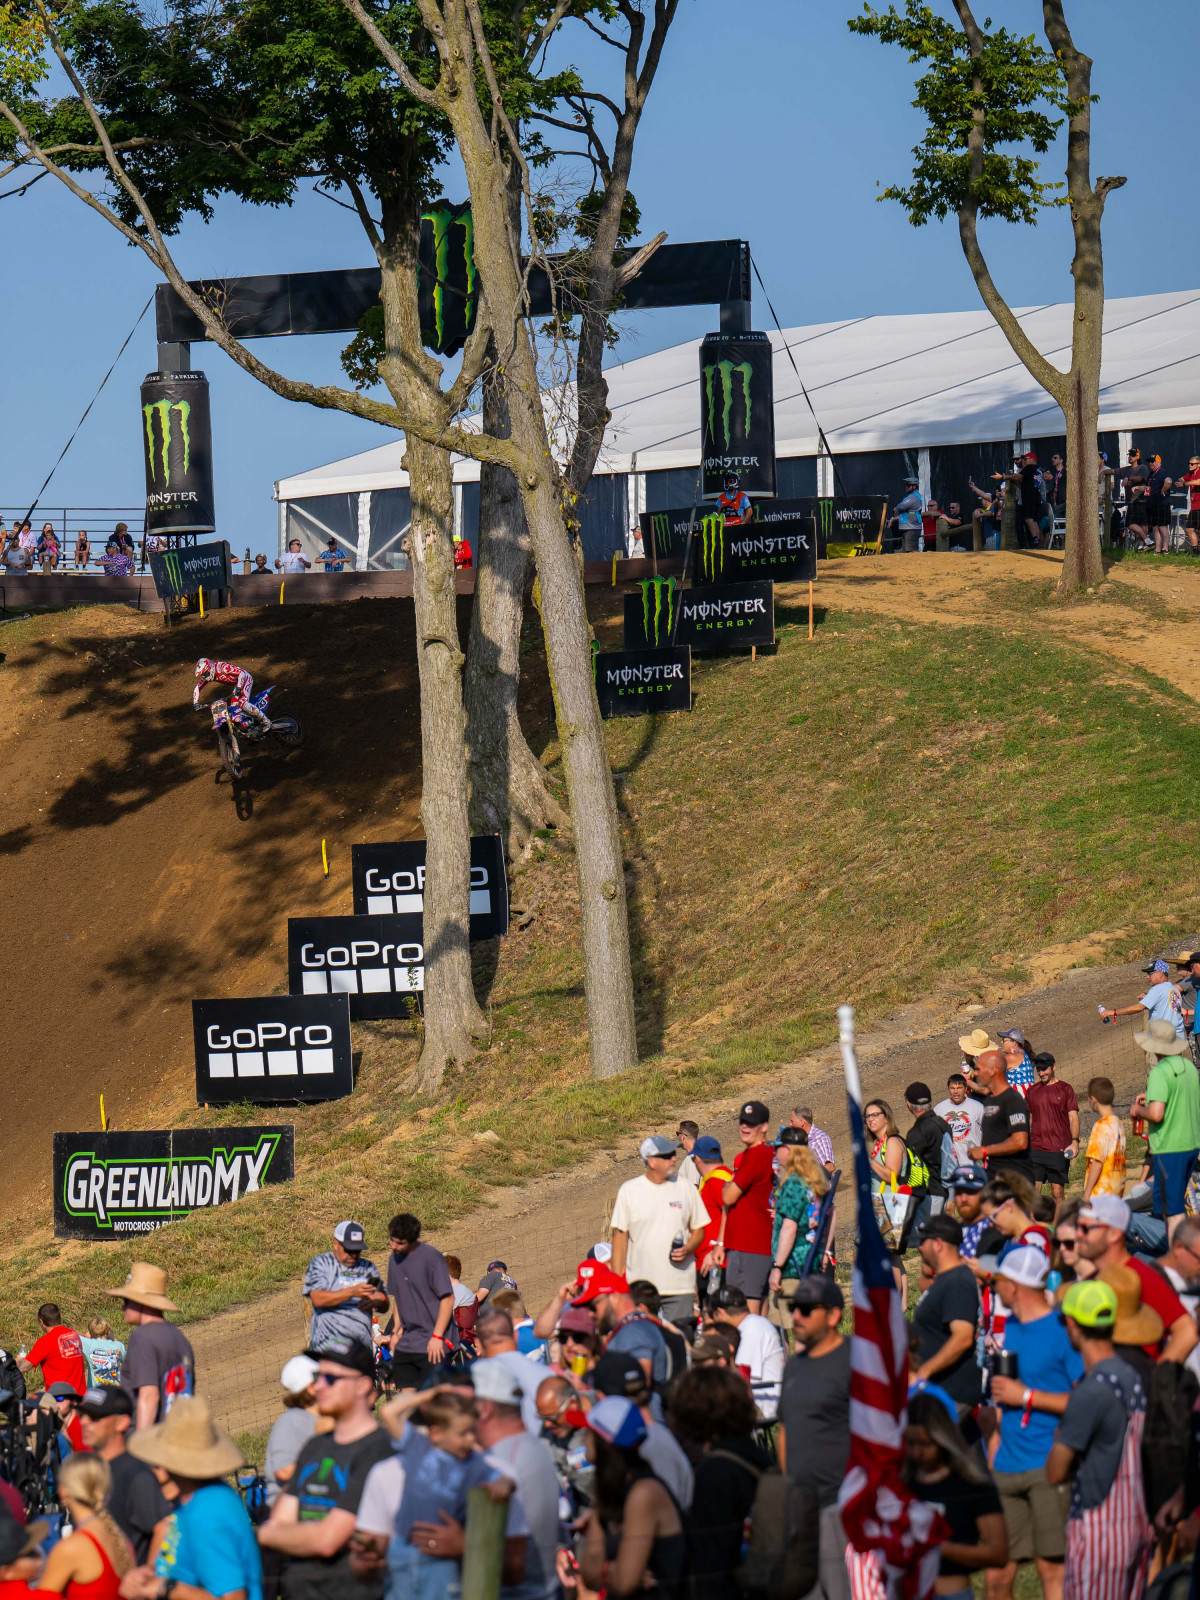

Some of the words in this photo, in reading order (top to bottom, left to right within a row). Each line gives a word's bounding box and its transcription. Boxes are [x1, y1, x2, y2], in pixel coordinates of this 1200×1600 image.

[702, 456, 760, 469] MONSTER
[149, 503, 189, 511] ENERGY
[835, 507, 872, 521] MONSTER
[731, 535, 810, 557] MONSTER
[184, 555, 222, 572] MONSTER
[741, 554, 797, 567] ENERGY
[683, 598, 766, 621] MONSTER
[696, 618, 755, 631] ENERGY
[606, 663, 684, 686] MONSTER
[618, 683, 673, 696] ENERGY
[300, 940, 424, 967] GoPro
[207, 1022, 333, 1049] GoPro
[113, 1221, 155, 1231] MOTOCROSS
